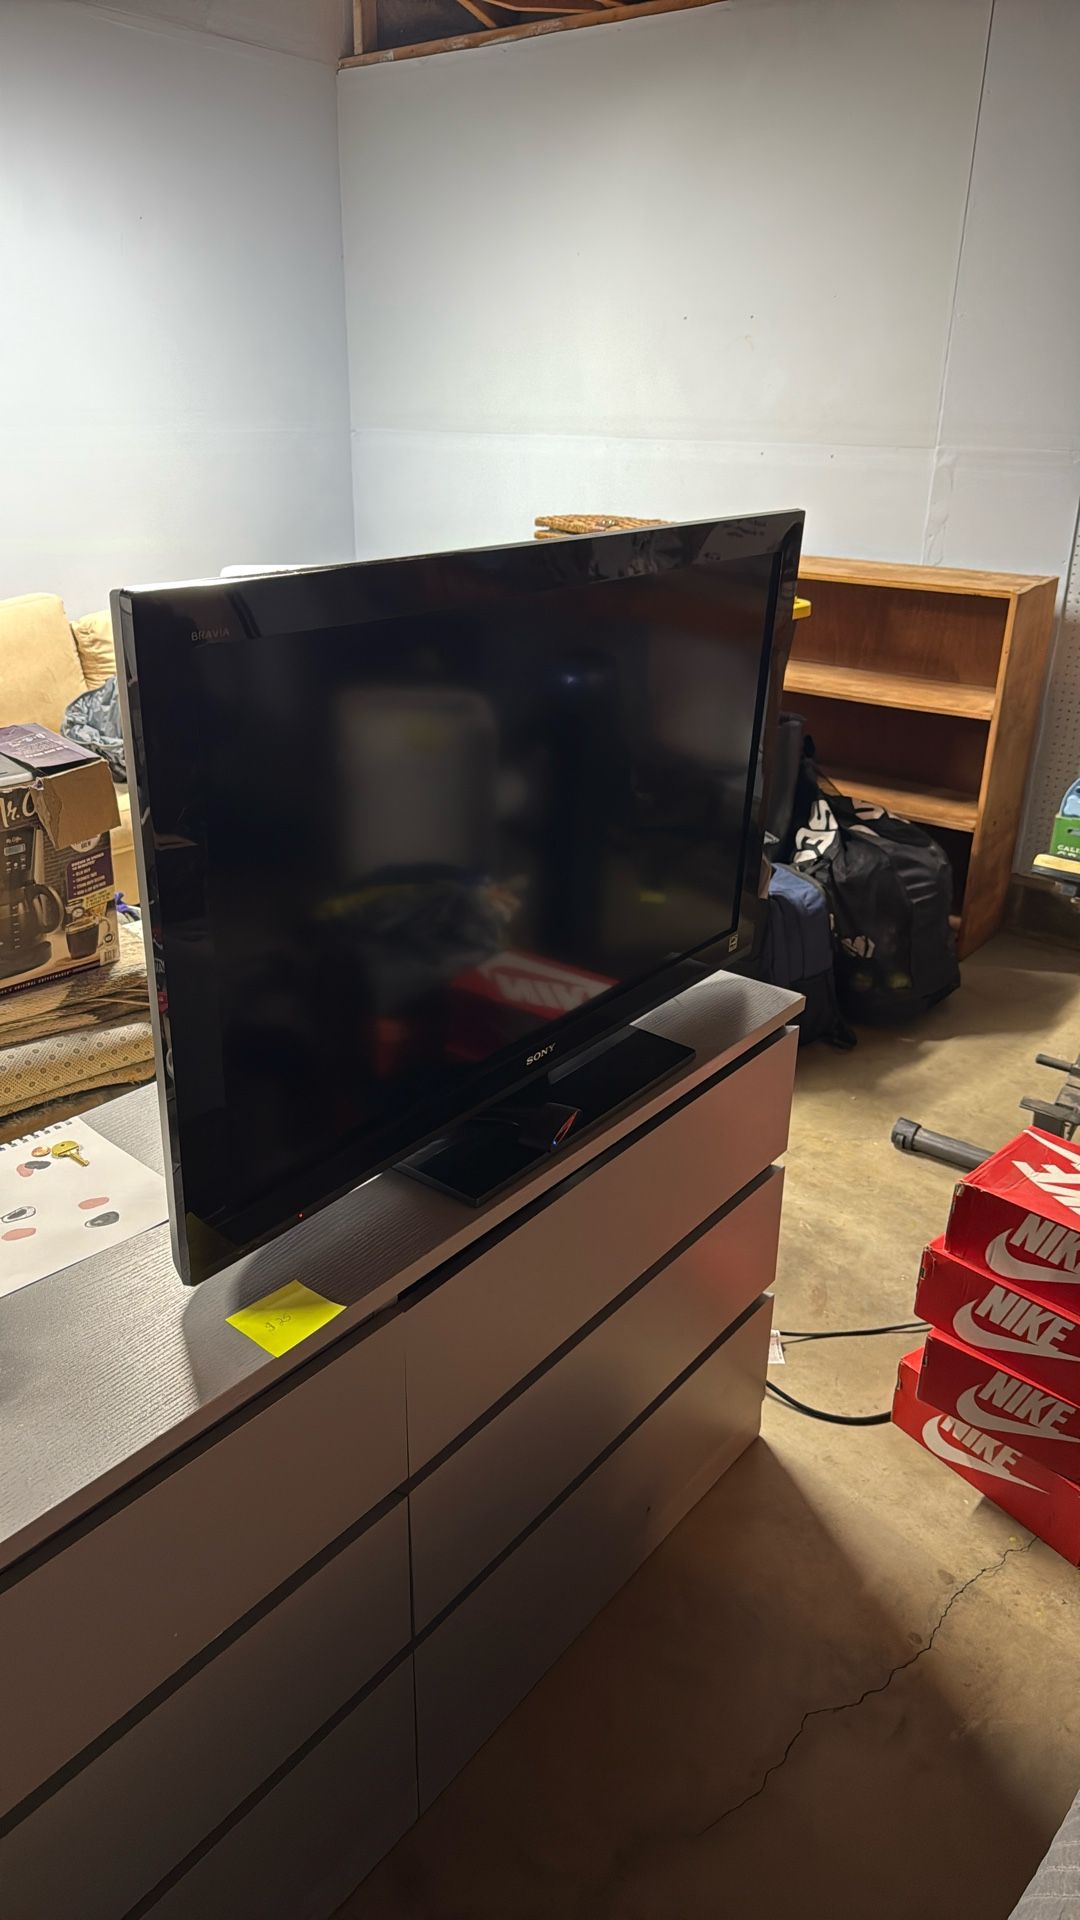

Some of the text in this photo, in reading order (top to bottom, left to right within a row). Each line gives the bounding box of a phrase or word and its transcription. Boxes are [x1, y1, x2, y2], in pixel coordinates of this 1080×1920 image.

[191, 629, 230, 641] BRAVIA
[526, 1042, 556, 1066] SONY
[1009, 1212, 1080, 1272] NIK
[975, 1284, 1076, 1350] NIKE
[977, 1371, 1077, 1433] NIKE
[940, 1415, 1023, 1474] NIKE
